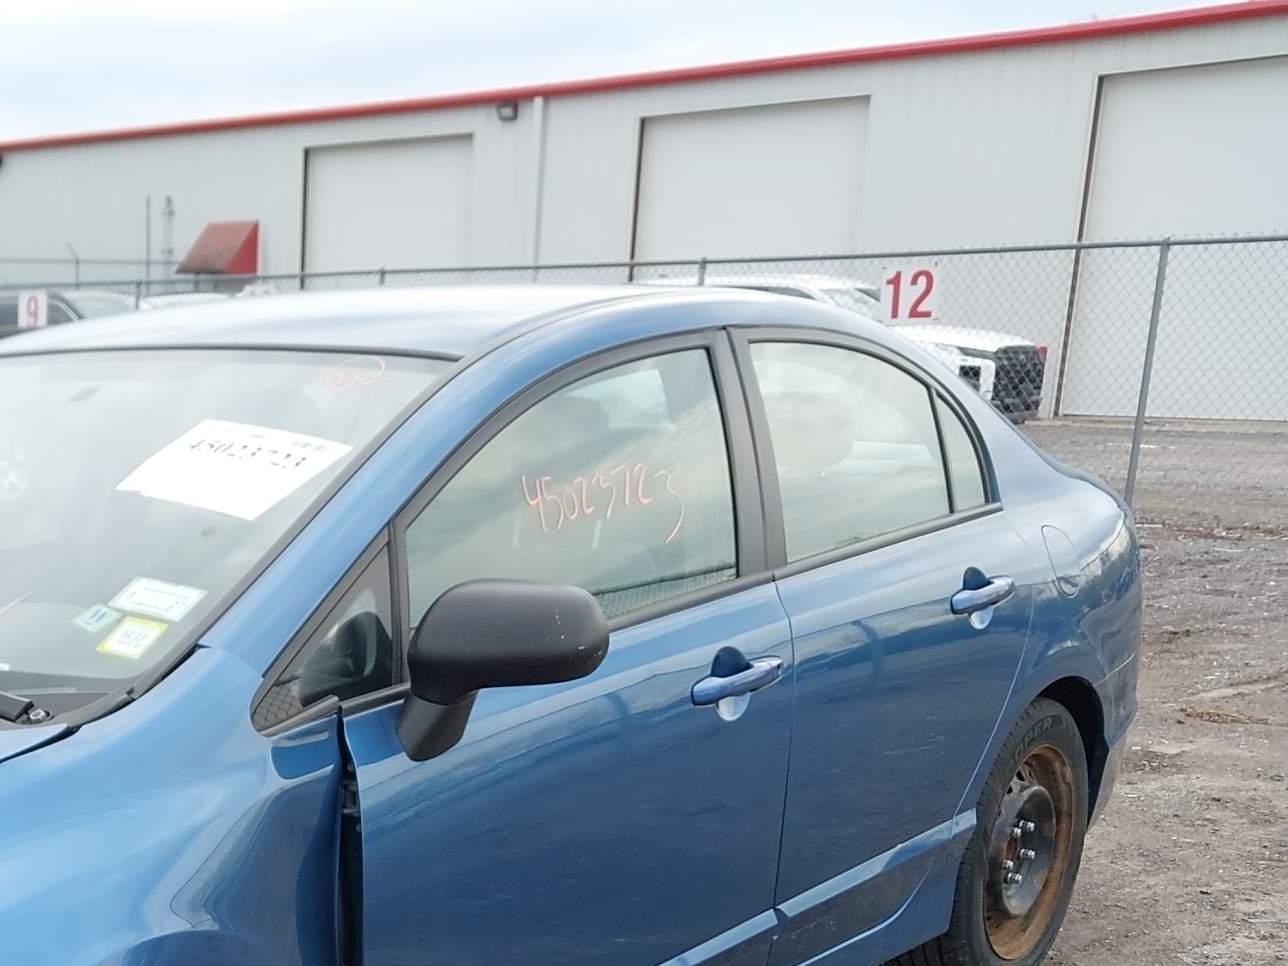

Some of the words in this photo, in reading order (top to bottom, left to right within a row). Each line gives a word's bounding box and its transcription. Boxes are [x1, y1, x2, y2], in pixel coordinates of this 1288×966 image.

[27, 296, 39, 327] 9
[886, 269, 934, 319] 12
[522, 464, 684, 544] 45023723
